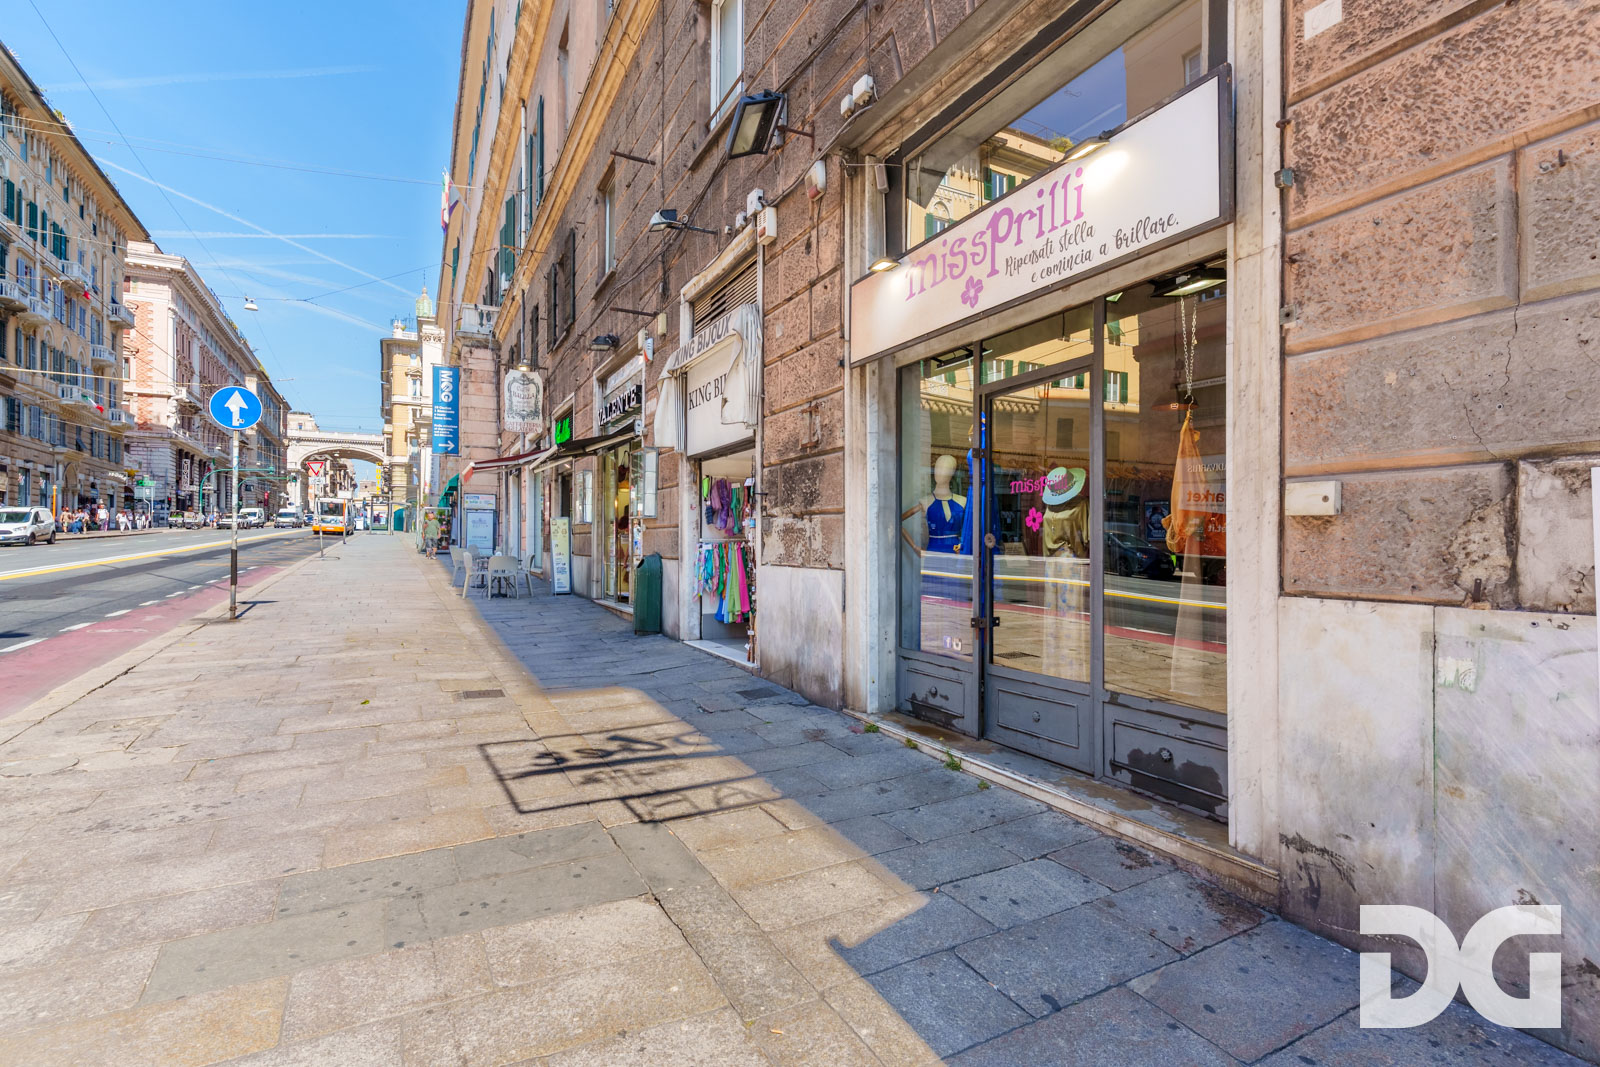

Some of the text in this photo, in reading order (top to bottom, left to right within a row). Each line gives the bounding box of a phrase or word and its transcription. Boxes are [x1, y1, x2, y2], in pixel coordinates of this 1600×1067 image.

[1005, 221, 1095, 277] Ripensati stella
[1031, 213, 1179, 283] e comincia a brillare.
[673, 314, 732, 368] KING BIJOUX
[598, 385, 638, 427] VALENTE
[688, 381, 712, 410] KING
